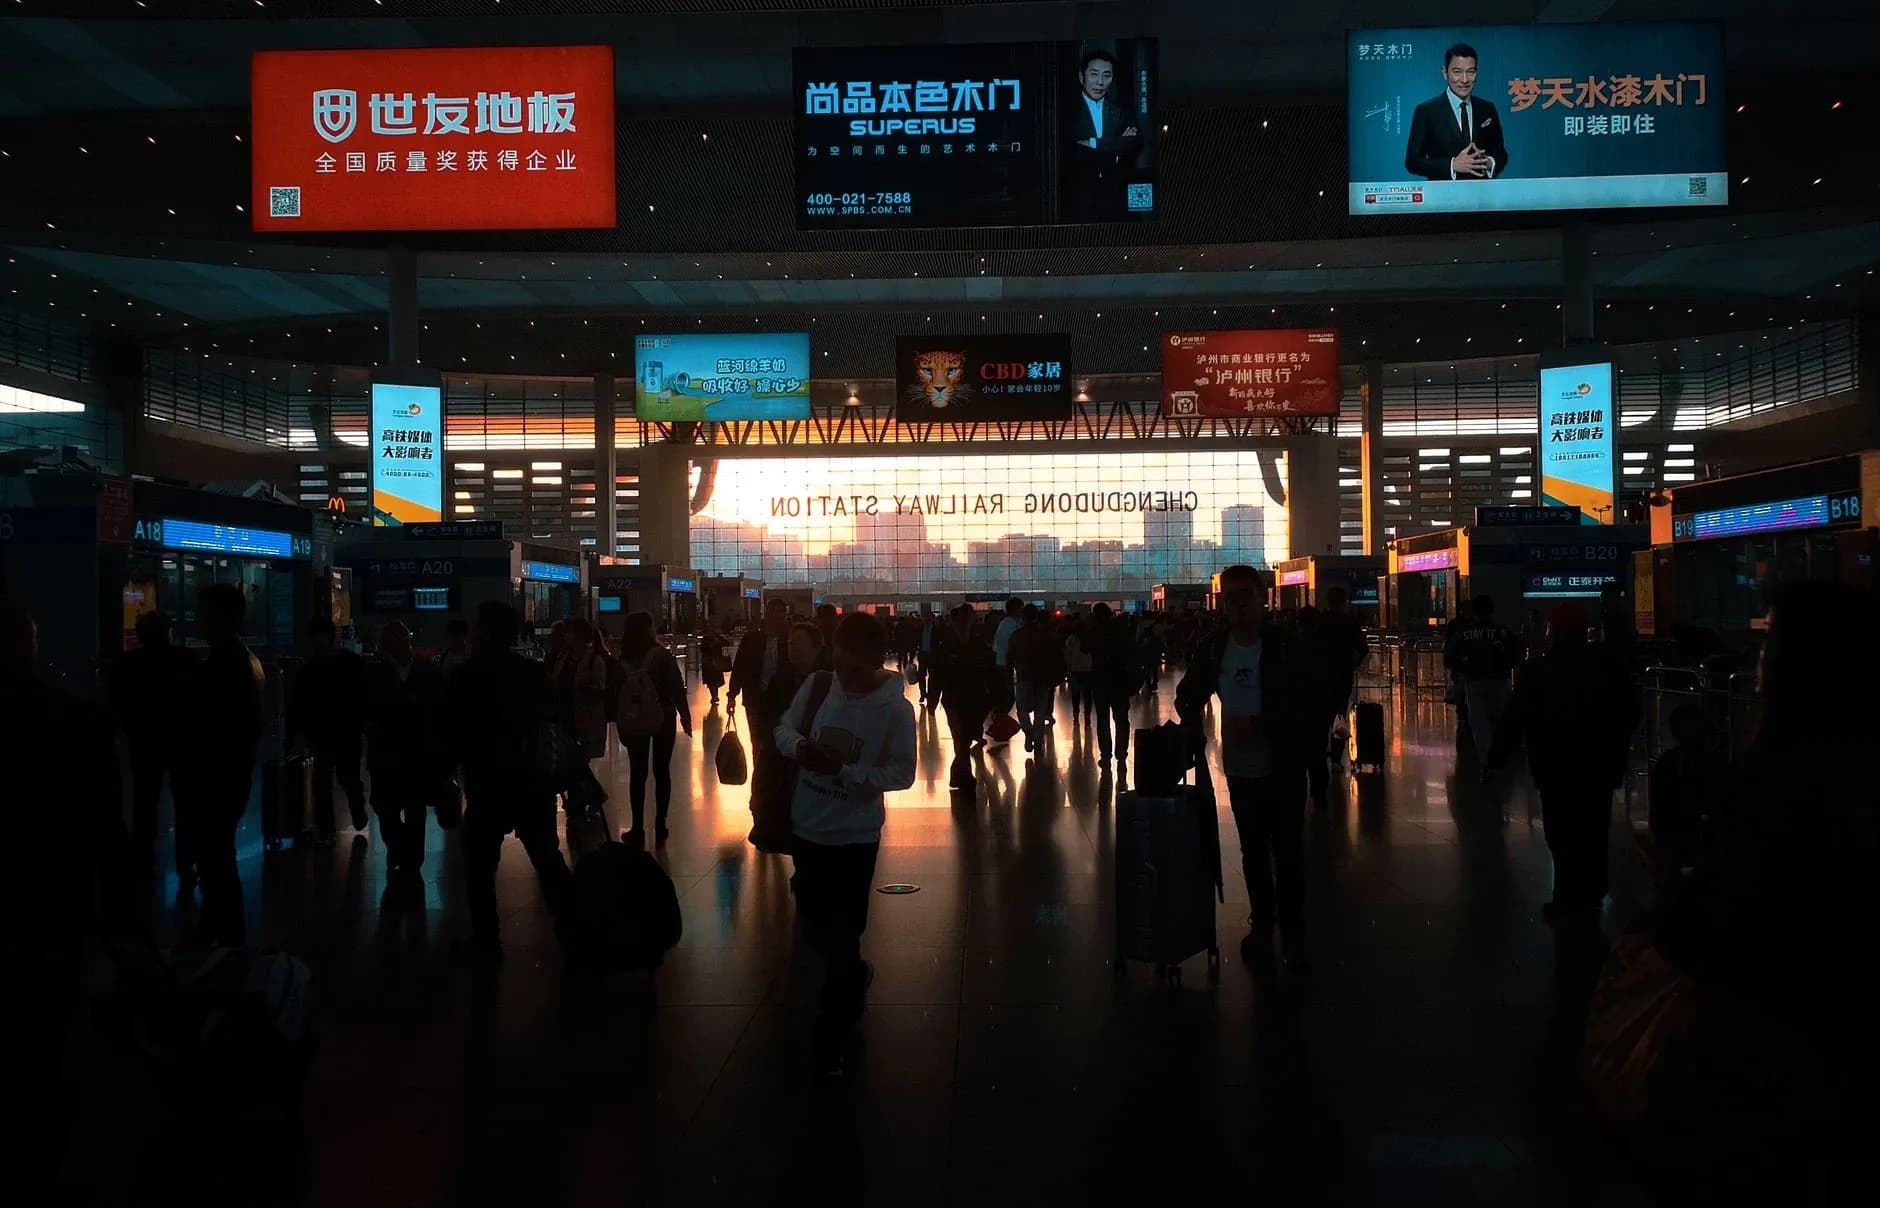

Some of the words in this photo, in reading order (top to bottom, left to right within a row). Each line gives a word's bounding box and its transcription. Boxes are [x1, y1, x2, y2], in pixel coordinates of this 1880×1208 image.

[1358, 43, 1413, 56] 梦天木门
[805, 78, 1021, 114] 尚品本色木门
[1508, 73, 1706, 112] 梦天水漆木门
[368, 91, 577, 135] 世友地板
[850, 118, 976, 136] SUPERUS
[1564, 114, 1655, 137] 即装即住
[807, 142, 1021, 156] 为空间而生的艺术木门
[315, 149, 577, 173] 全国质量奖获得企业
[807, 192, 911, 206] 400-021-7588
[807, 206, 911, 216] WWW.SPBS.COM.CN
[717, 358, 786, 373] 蓝河绵羊奶
[1197, 352, 1311, 365] 泸州市商业银行更名为
[702, 377, 749, 394] 吸收好
[1550, 409, 1603, 426] 高铁媒体
[381, 429, 433, 444] 高铁媒体
[1551, 427, 1603, 442] 大影响者
[382, 445, 433, 460] 大影响者
[1831, 496, 1860, 518] B18
[134, 520, 161, 541] A18
[1674, 520, 1693, 536] B19
[293, 538, 311, 555] A19
[1585, 546, 1617, 560] B20
[422, 560, 454, 575] A20
[608, 578, 633, 590] A22
